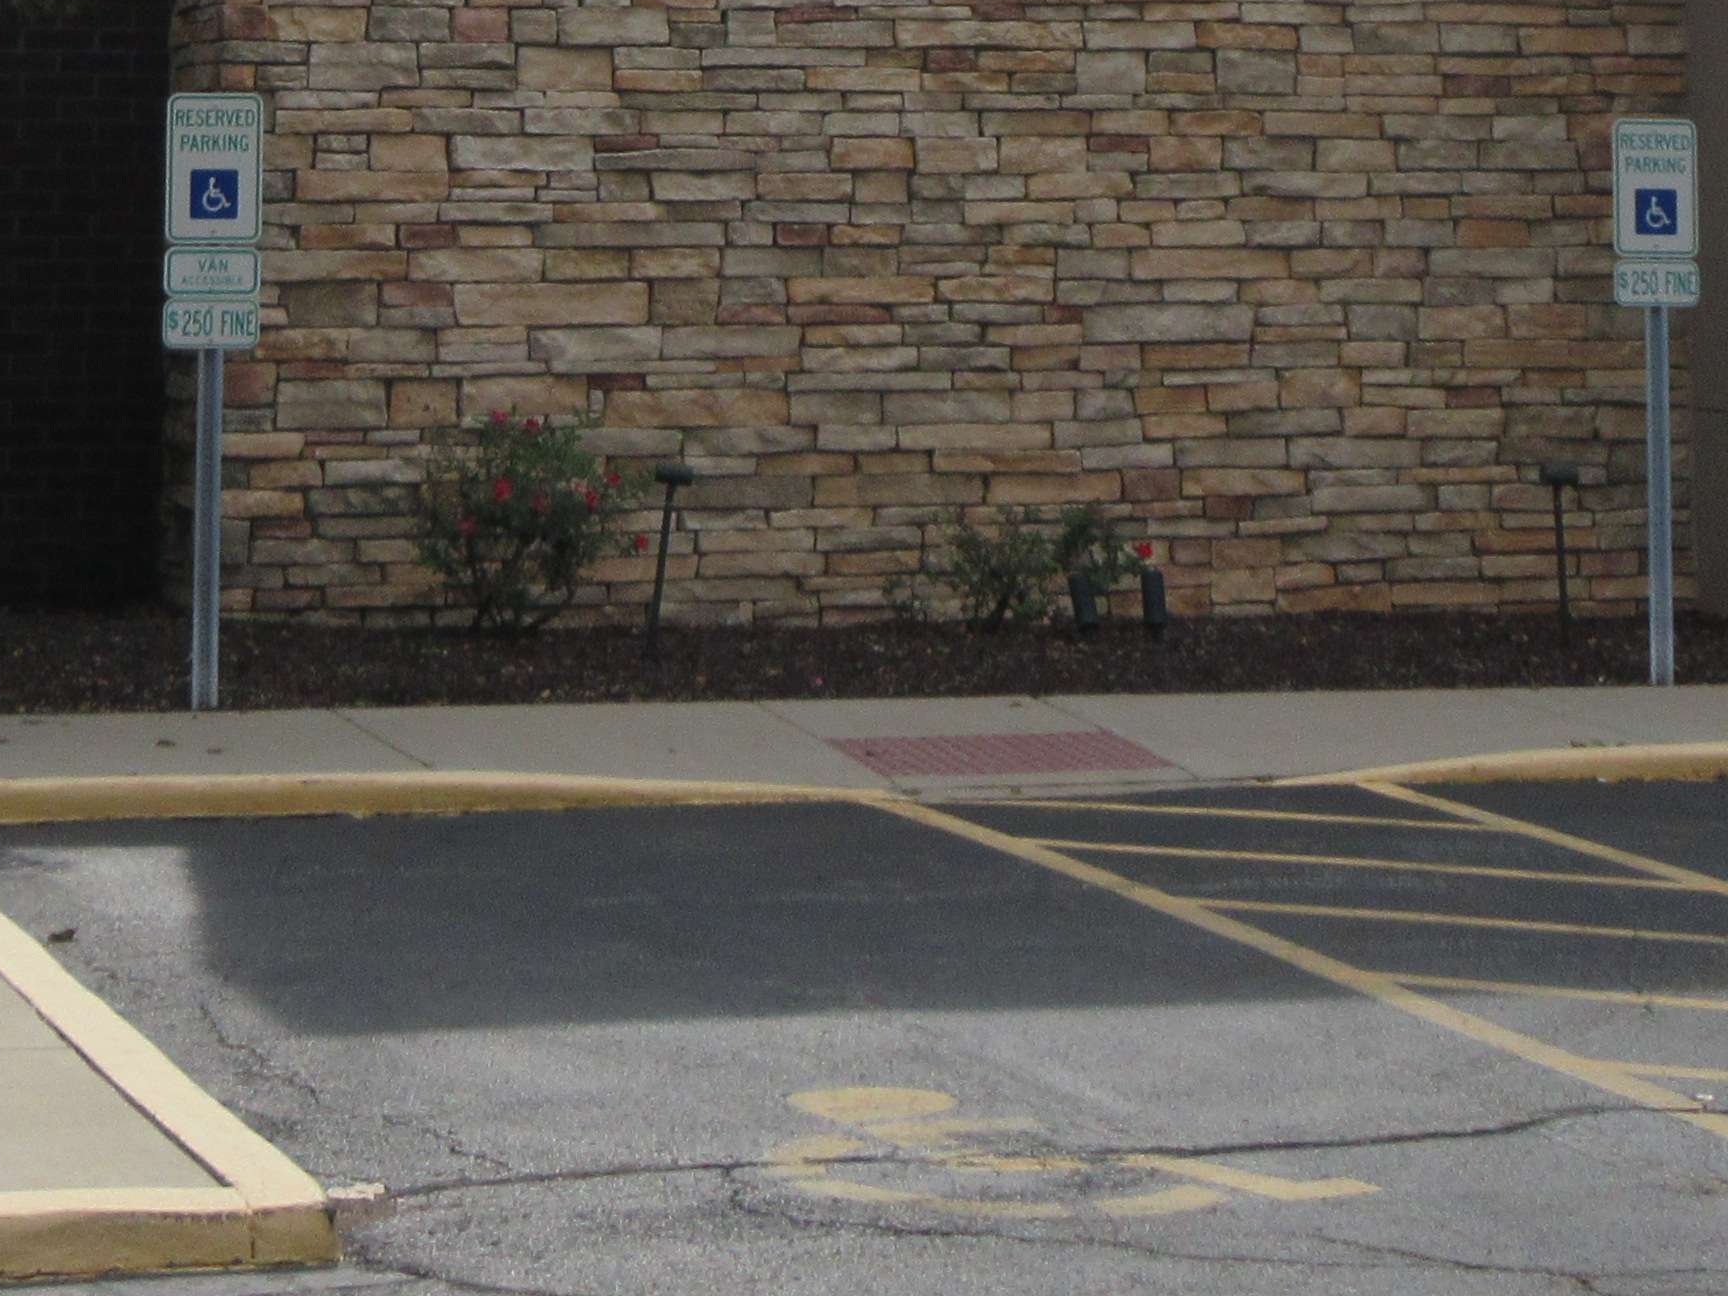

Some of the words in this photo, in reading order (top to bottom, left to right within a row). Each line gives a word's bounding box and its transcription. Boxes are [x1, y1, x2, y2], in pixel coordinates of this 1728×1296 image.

[175, 108, 256, 128] RESERVED
[179, 133, 250, 152] PARKING
[1621, 133, 1691, 151] RESERVED
[1625, 157, 1687, 175] PARKING
[198, 258, 229, 273] VAN
[221, 309, 256, 337] FINE
